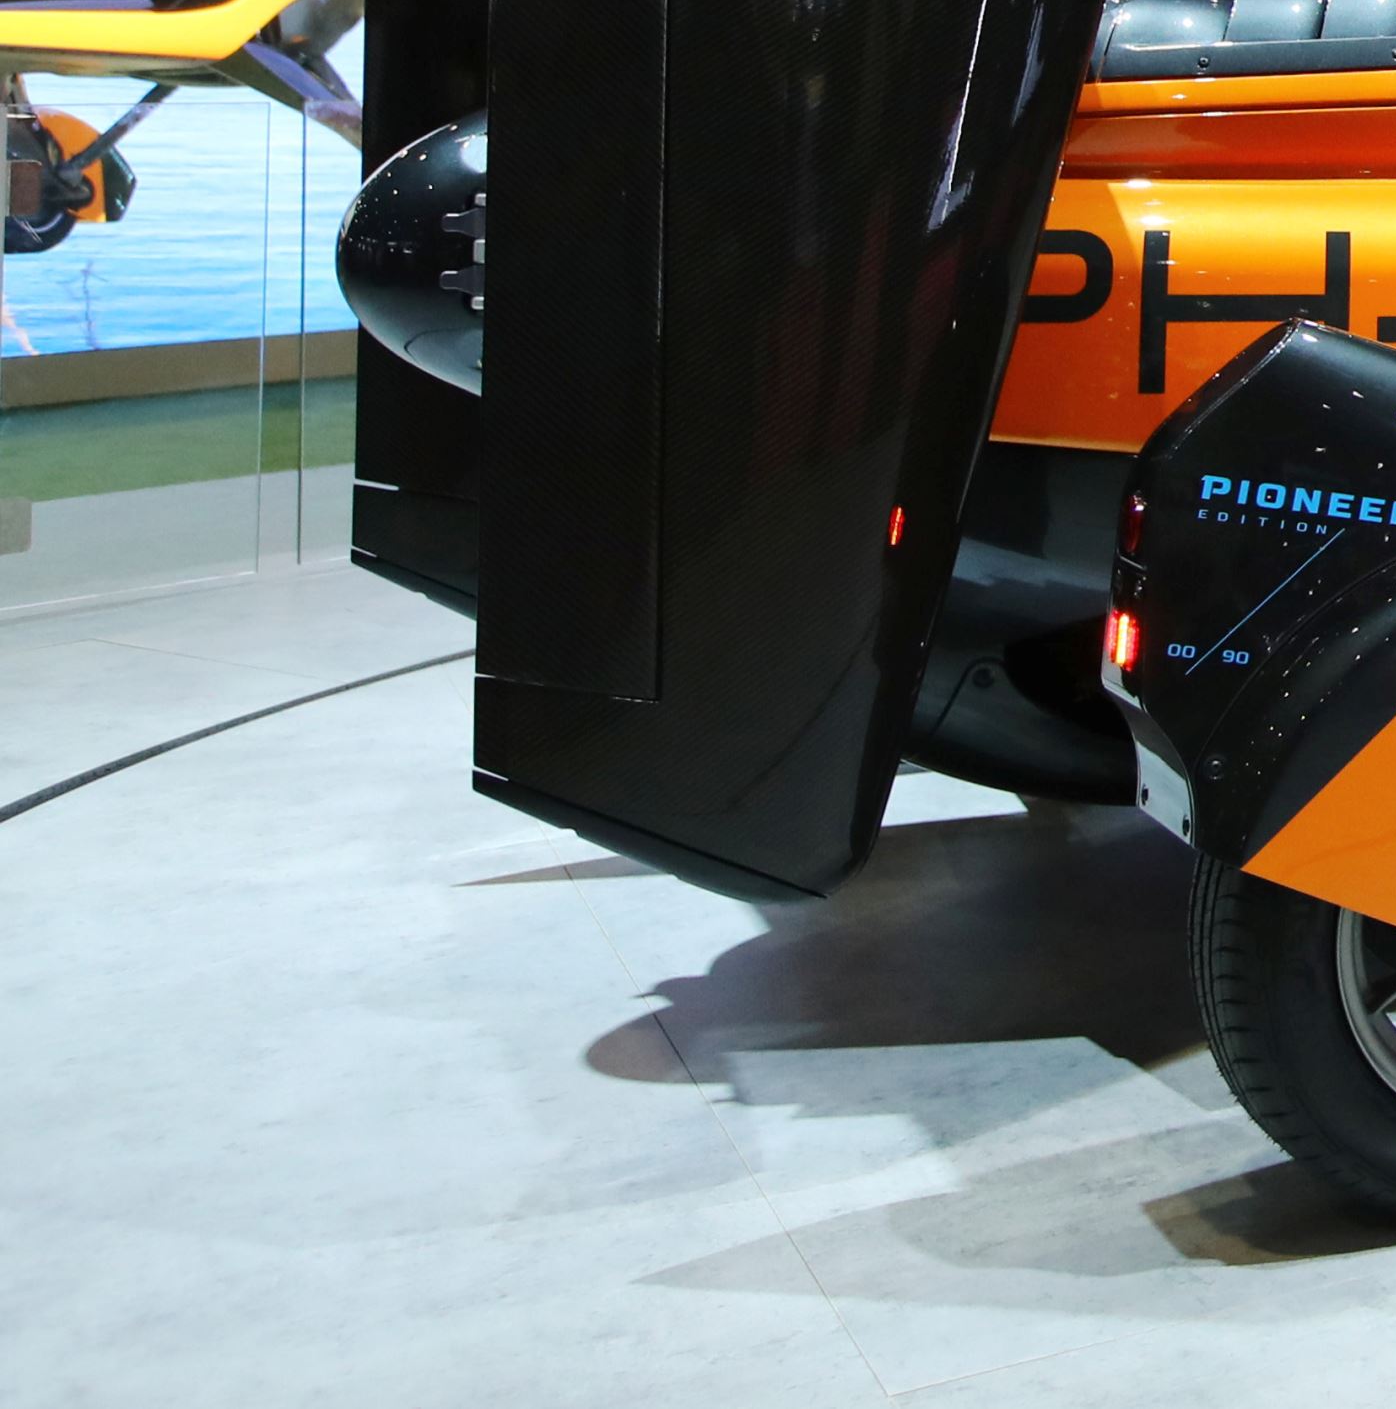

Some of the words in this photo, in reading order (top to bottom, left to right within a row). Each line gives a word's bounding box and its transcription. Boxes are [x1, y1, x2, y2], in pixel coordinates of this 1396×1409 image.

[1197, 509, 1327, 535] EDITION
[1167, 643, 1196, 659] 00
[1222, 649, 1250, 665] 90
